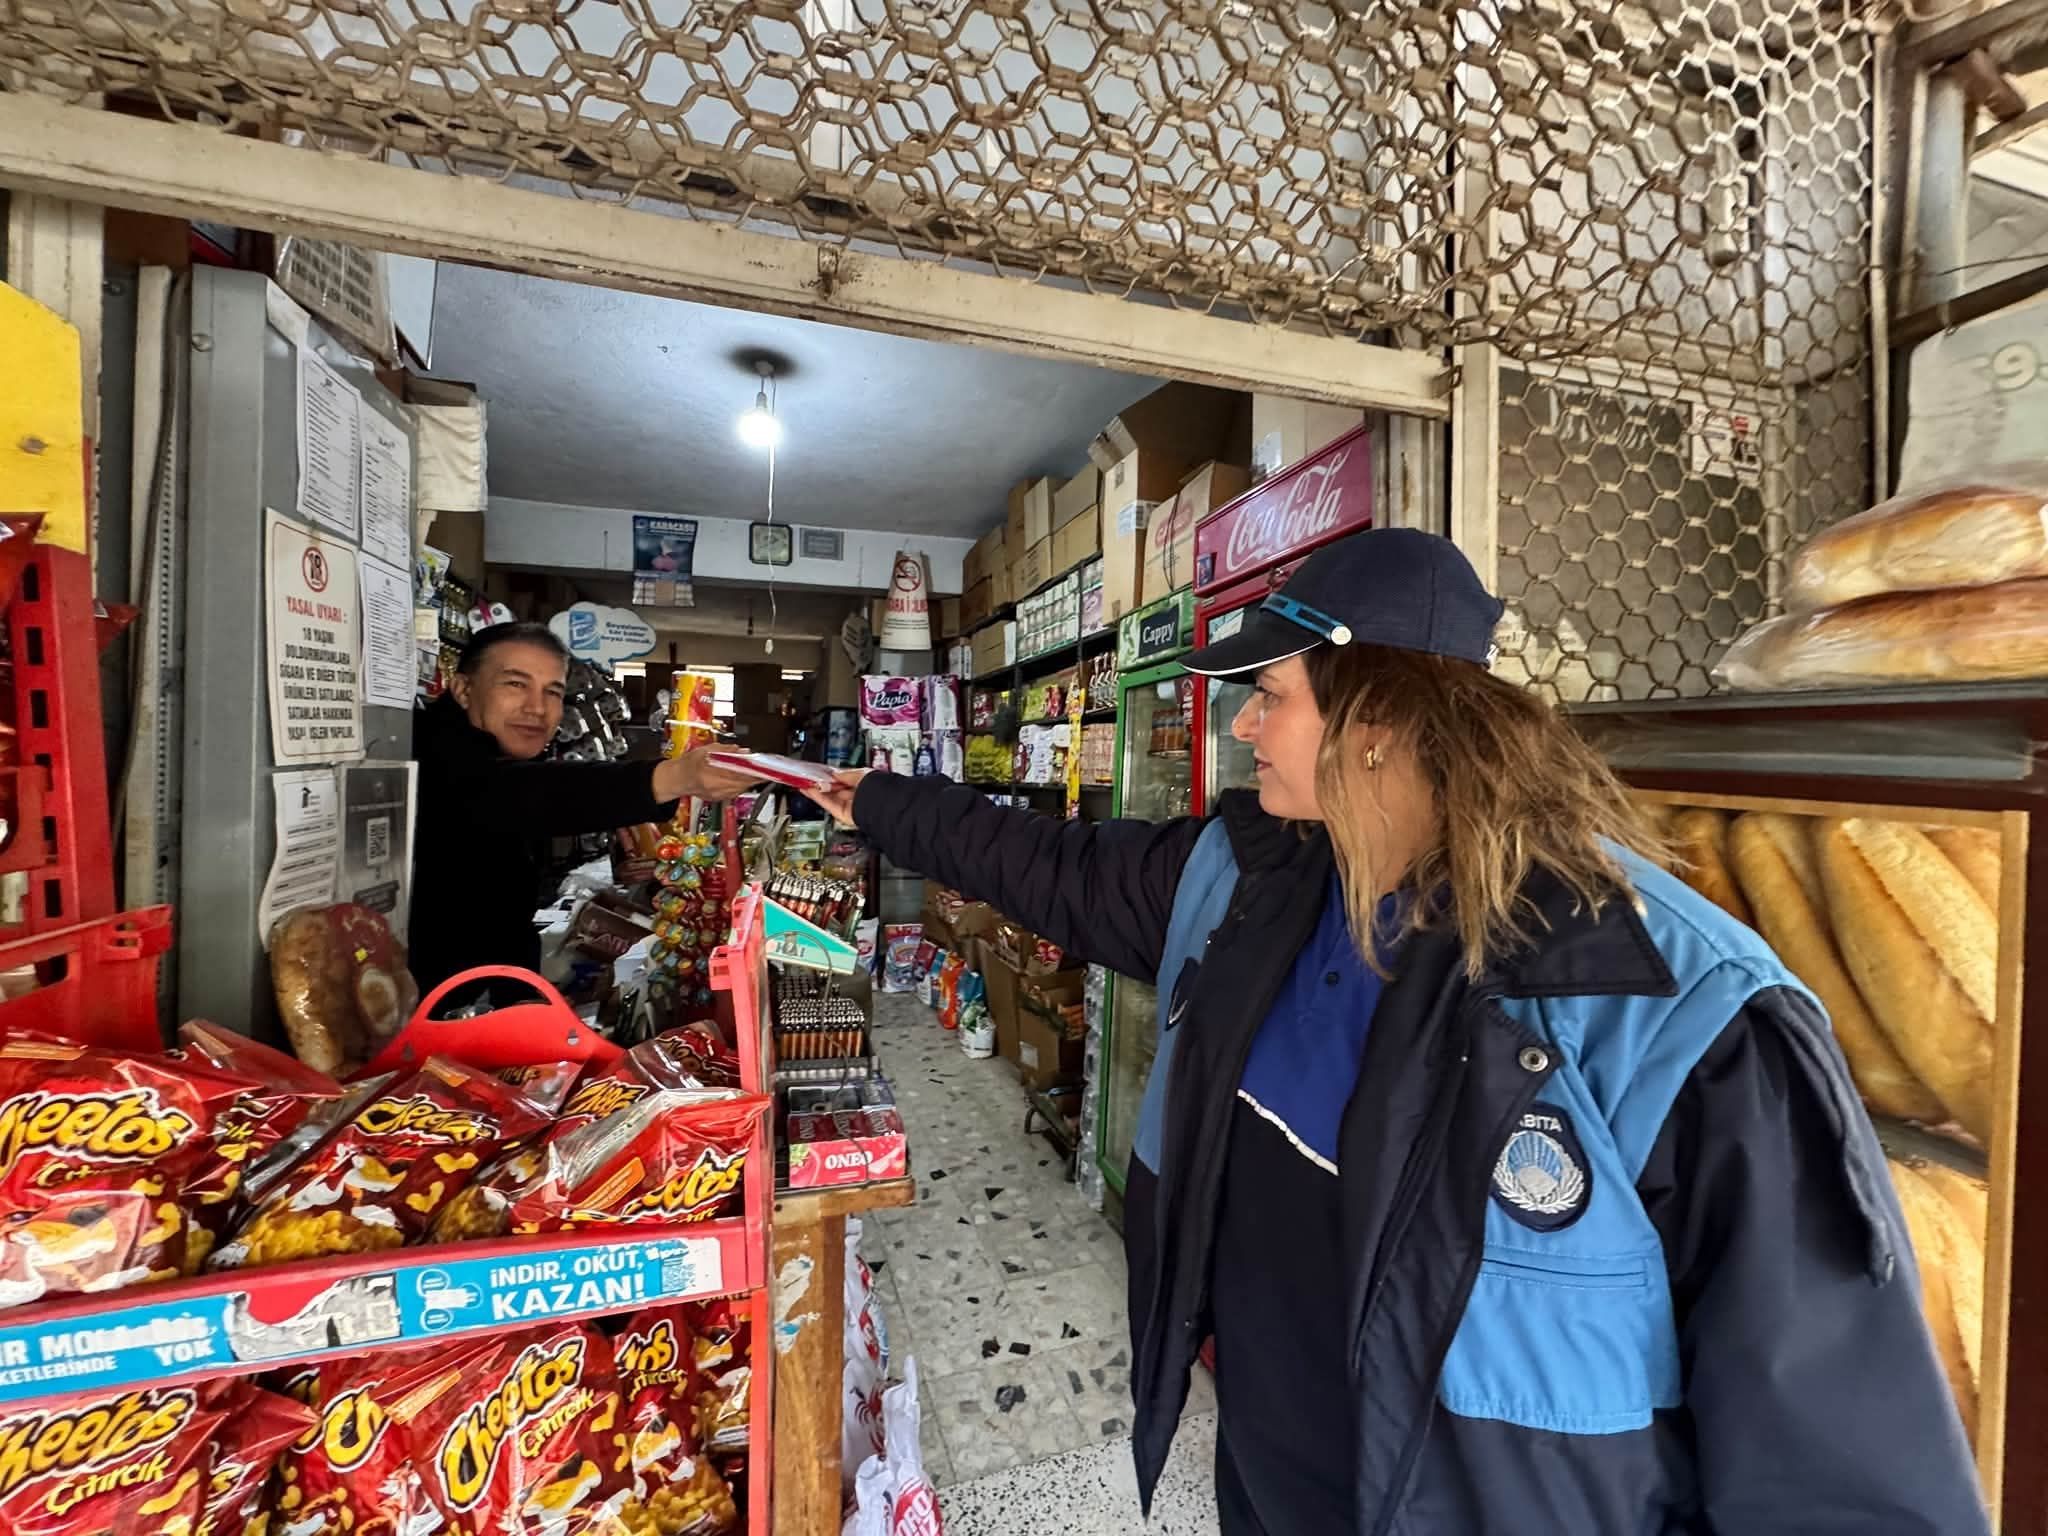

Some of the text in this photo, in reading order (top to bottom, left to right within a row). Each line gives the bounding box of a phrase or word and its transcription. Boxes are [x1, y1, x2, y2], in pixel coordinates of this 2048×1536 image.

[286, 596, 315, 618] YASAL
[1142, 622, 1176, 645] Cappy
[872, 691, 912, 711] Papia
[1518, 1113, 1563, 1132] BITA
[0, 1096, 190, 1183] heetos
[573, 1250, 644, 1276] OKUT,
[491, 1273, 645, 1321] KAZAN!
[154, 1339, 216, 1367] YOK
[442, 1341, 582, 1503] Cheetos
[0, 1391, 190, 1492] heetos
